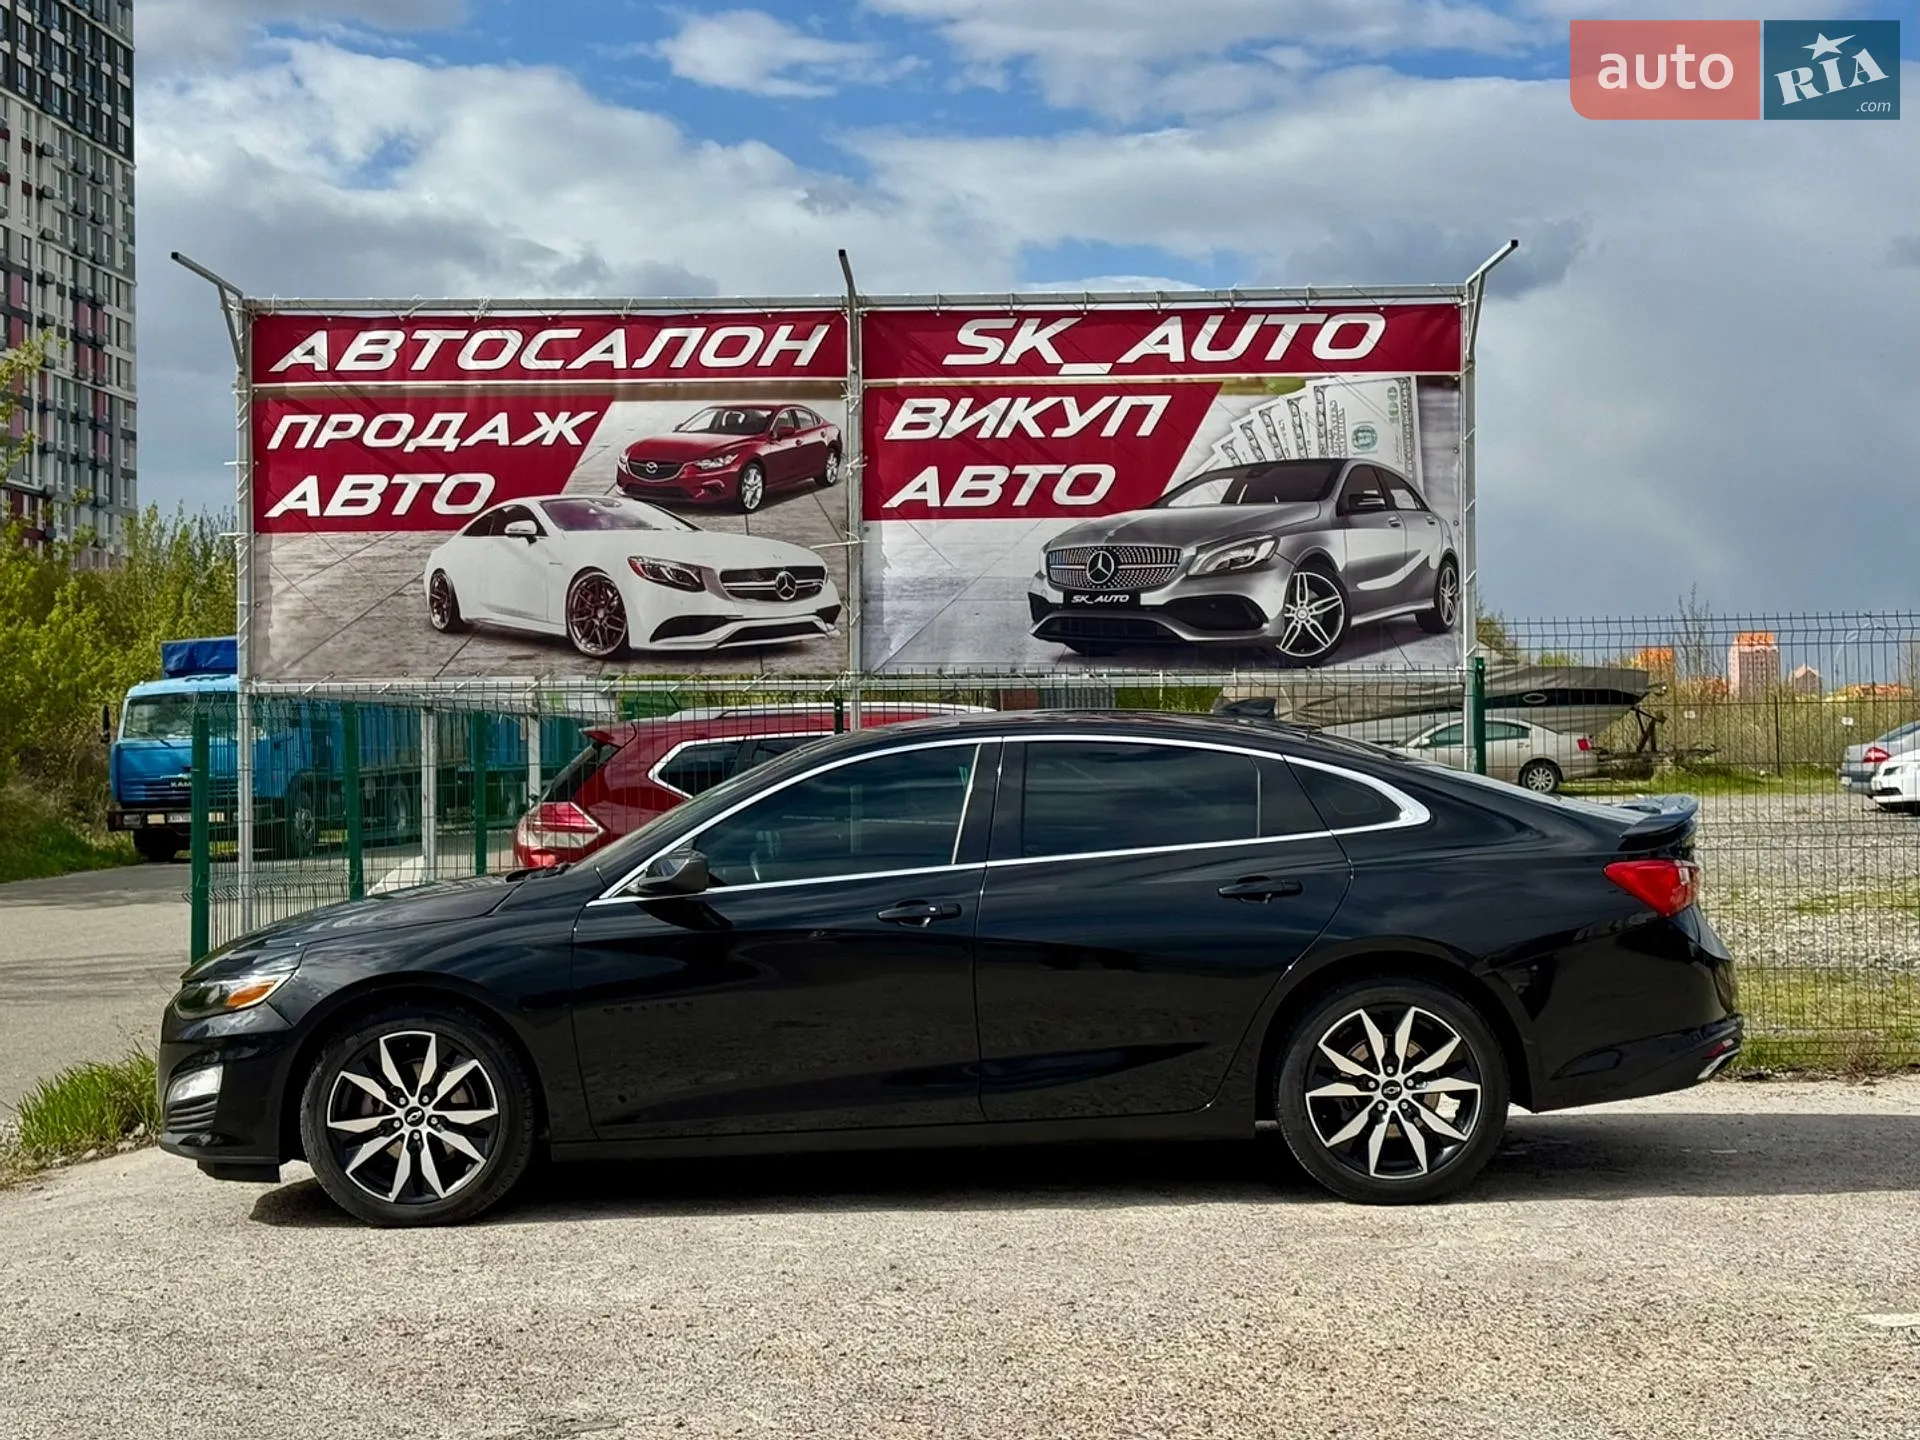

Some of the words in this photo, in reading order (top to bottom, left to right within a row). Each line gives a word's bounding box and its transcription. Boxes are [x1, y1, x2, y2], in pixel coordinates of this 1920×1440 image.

[269, 324, 830, 372] АВТОСАЛОН
[942, 313, 1387, 375] SK_AUTO
[266, 411, 608, 456] ПРОДАЖ
[884, 395, 1172, 440] ВИКУП
[264, 473, 496, 518] АВТО
[882, 463, 1116, 508] АВТО
[1070, 594, 1130, 604] SK_AUTO
